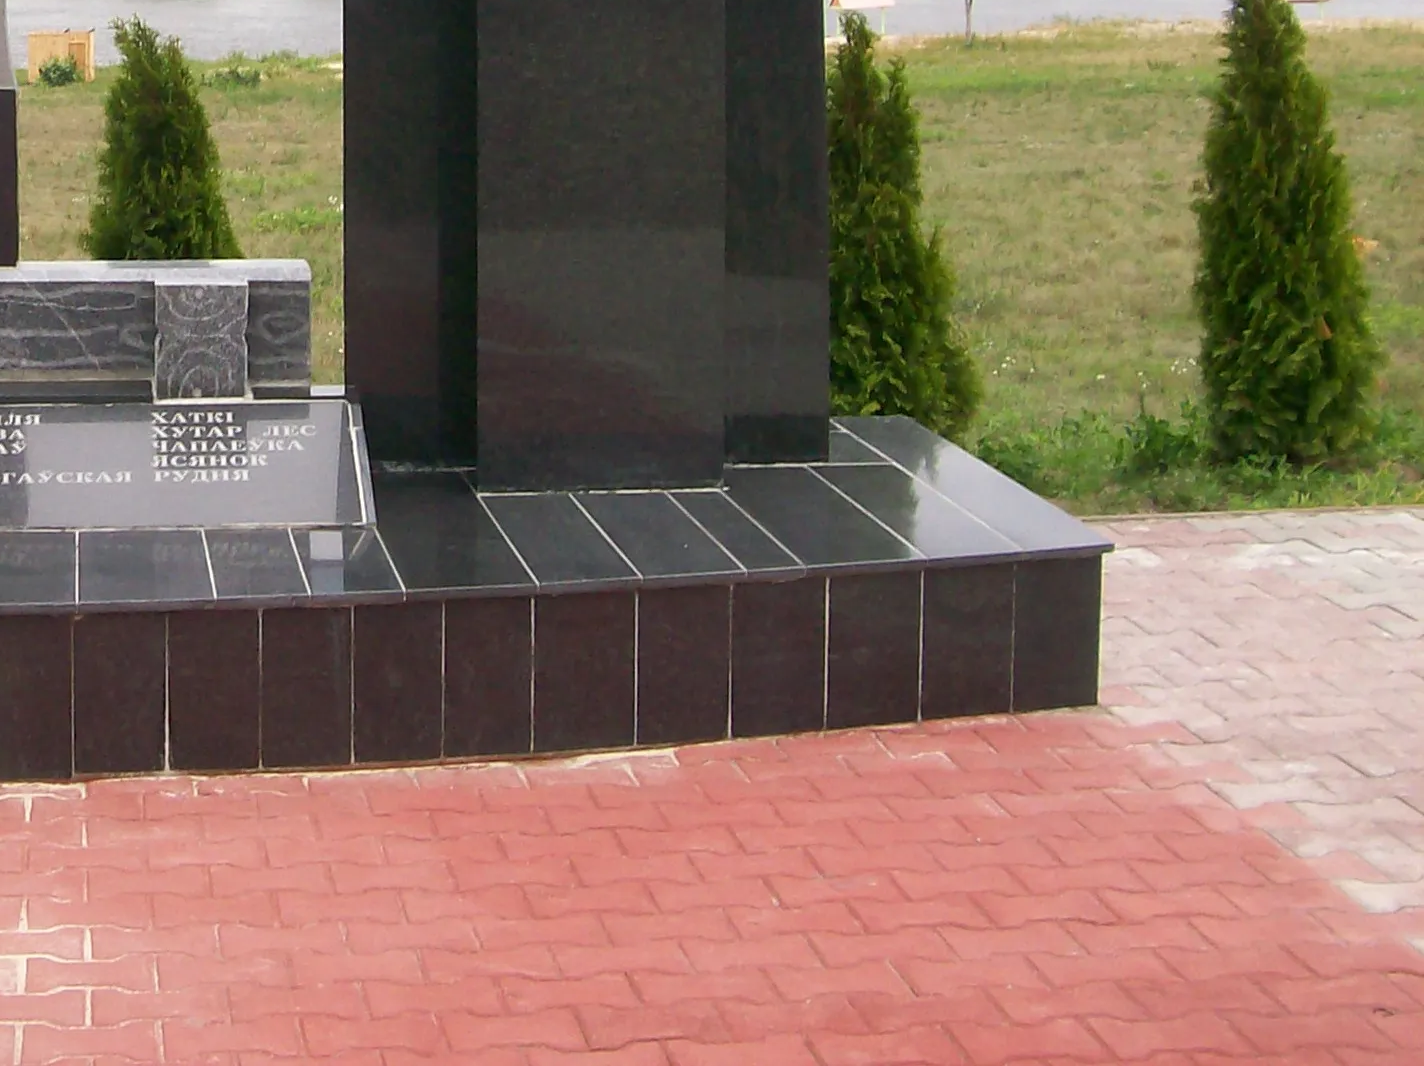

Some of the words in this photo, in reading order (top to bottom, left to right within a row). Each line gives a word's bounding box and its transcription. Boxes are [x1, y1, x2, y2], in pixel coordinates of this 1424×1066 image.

[150, 411, 236, 425] ХАТКІ
[150, 425, 243, 439] ХУТАР
[262, 424, 318, 437] ЛЕС
[150, 453, 269, 468] ЯСЯНОК
[153, 469, 251, 483] РУДНЯ
